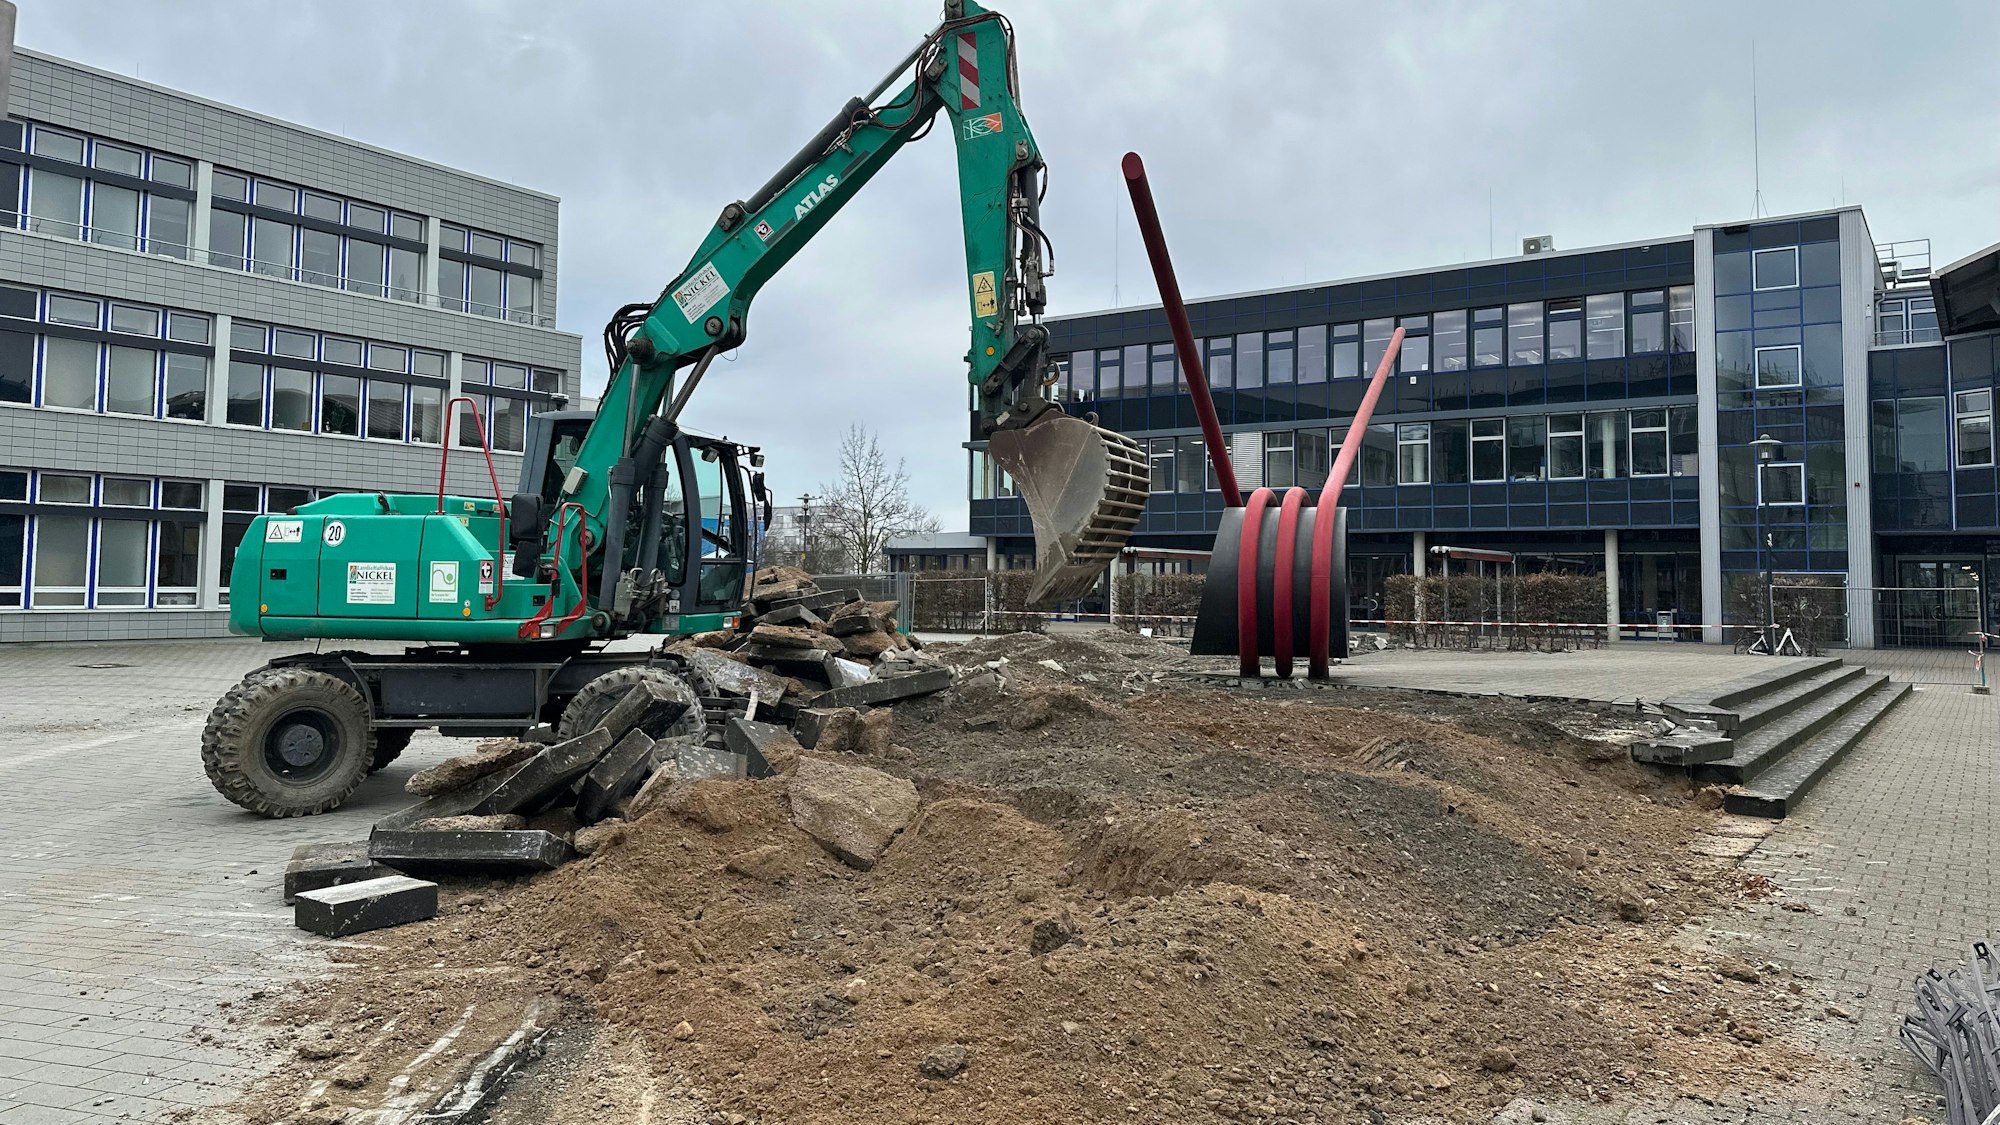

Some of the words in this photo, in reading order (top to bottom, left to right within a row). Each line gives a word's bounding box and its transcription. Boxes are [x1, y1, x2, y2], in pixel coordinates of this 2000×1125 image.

[794, 174, 839, 221] ATLAS
[683, 270, 718, 300] NICKEL
[328, 525, 342, 542] 20
[356, 571, 394, 580] NICKEL
